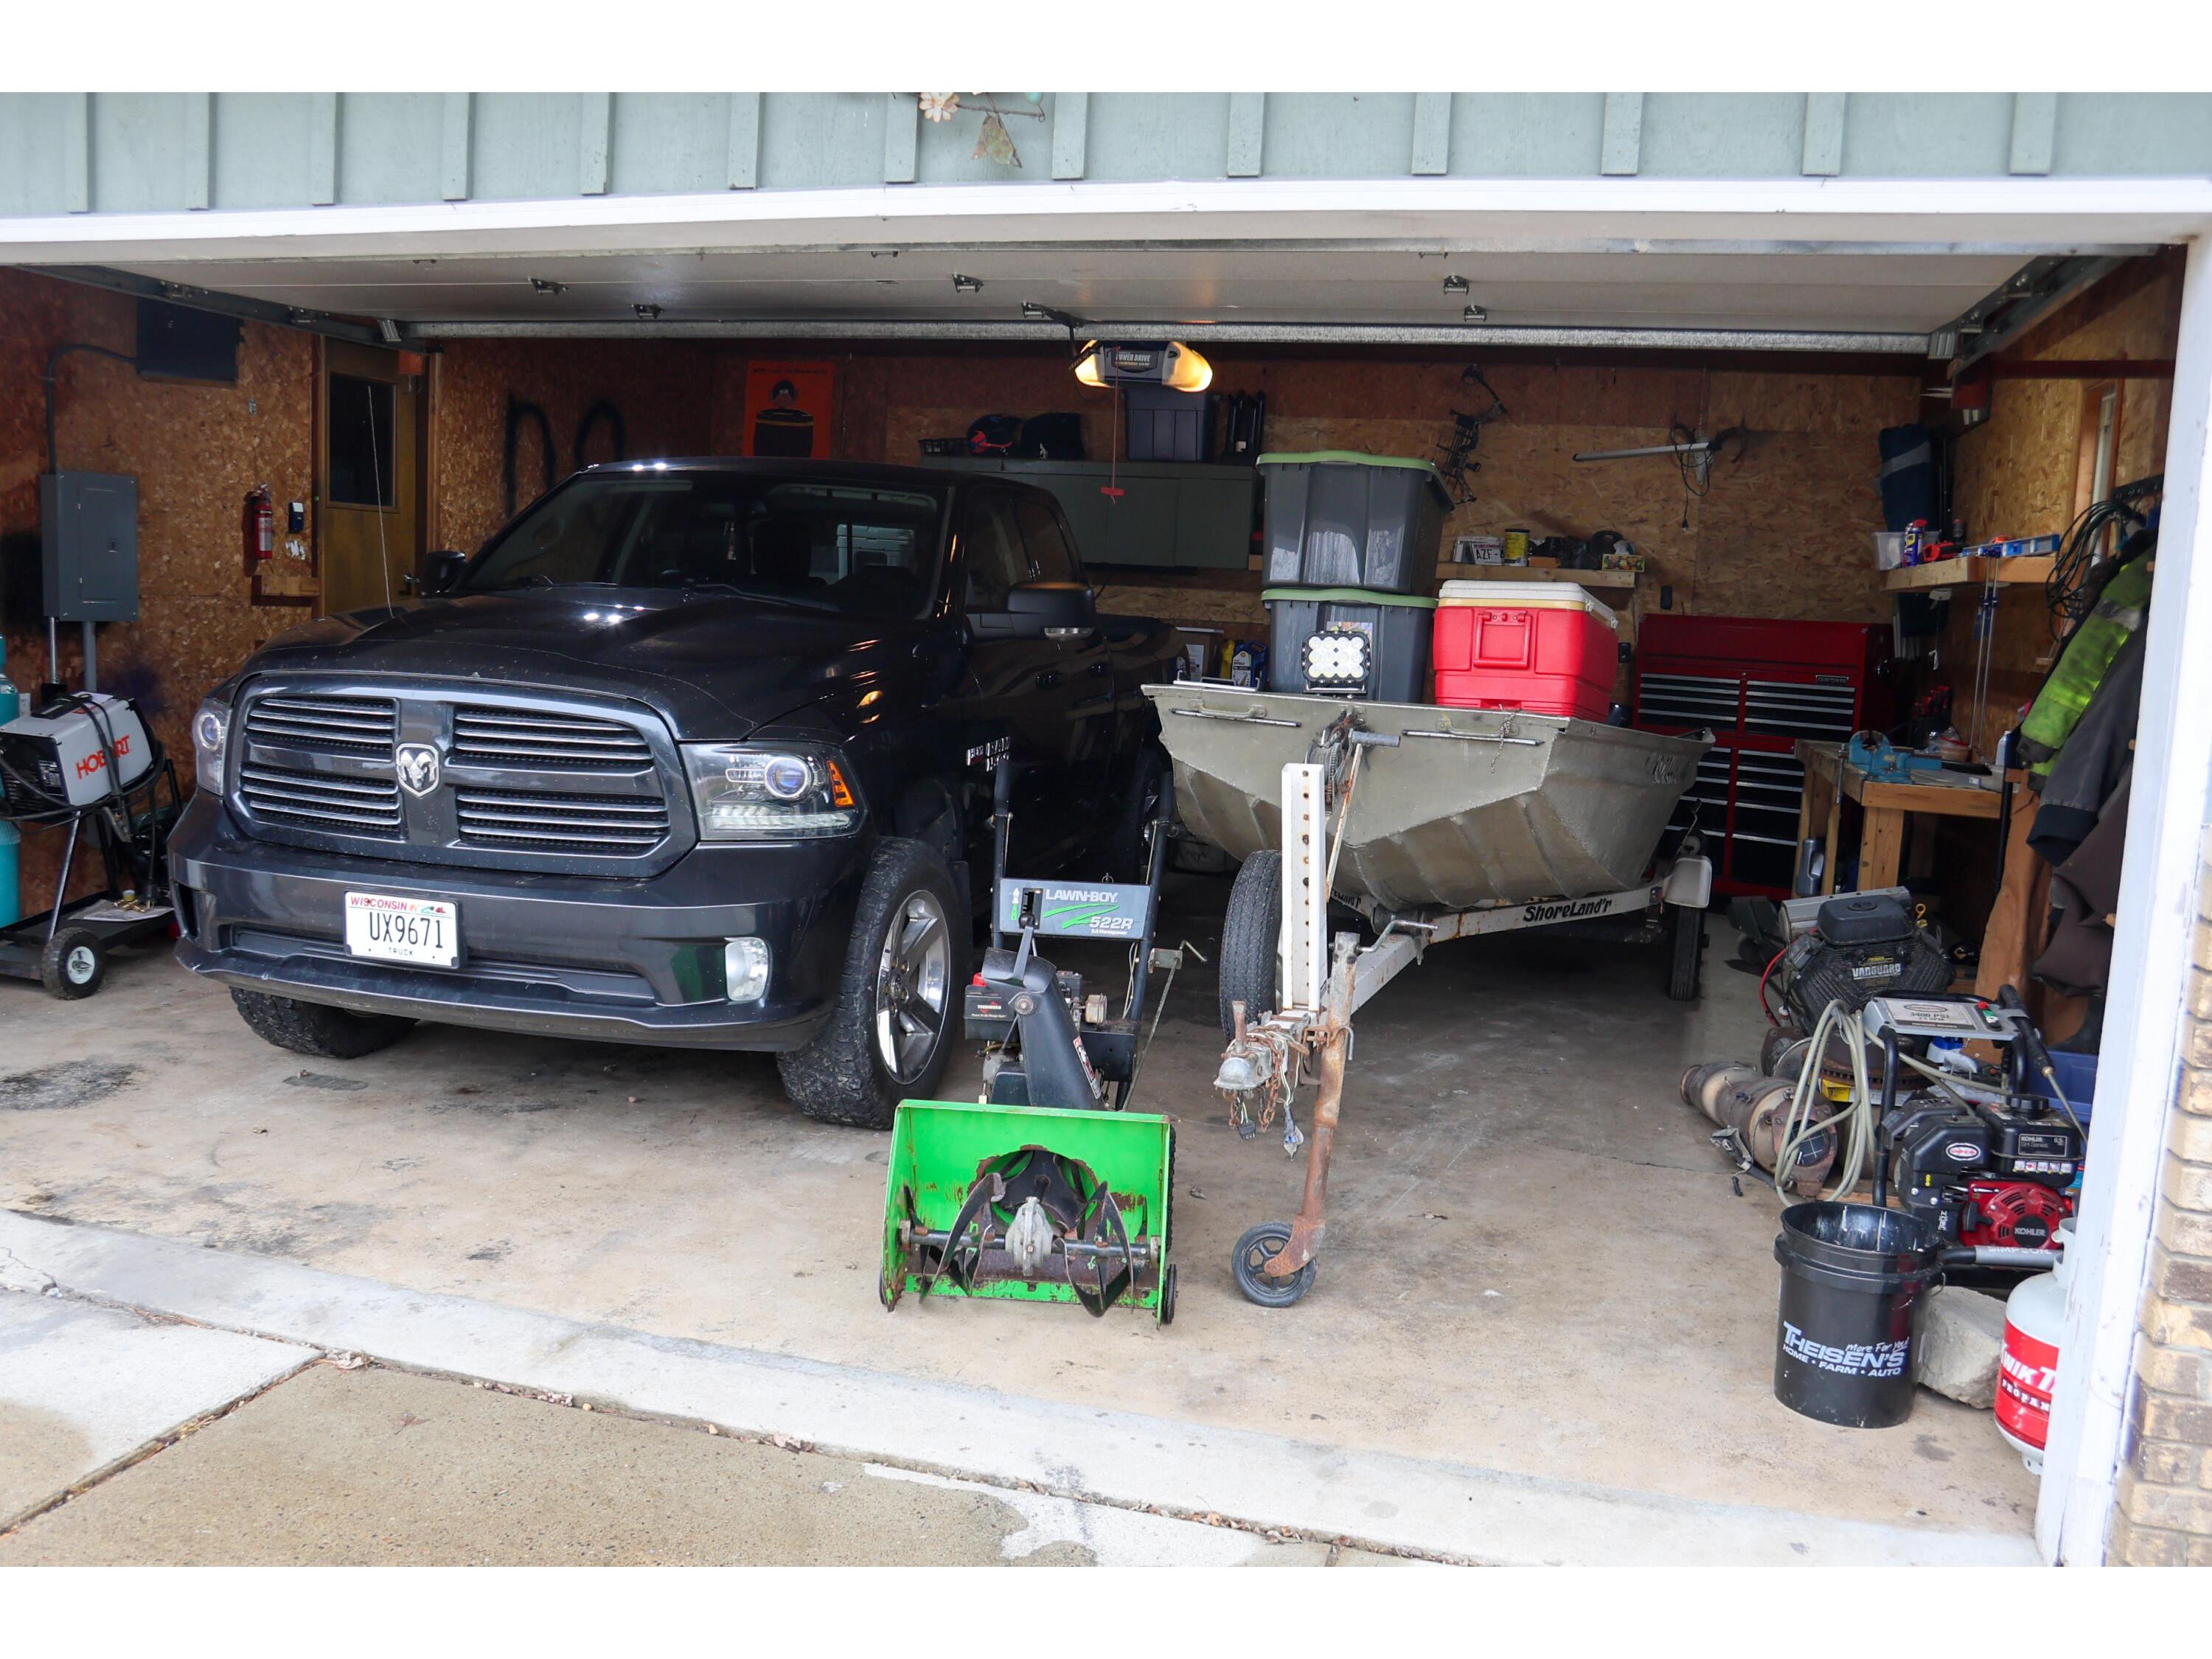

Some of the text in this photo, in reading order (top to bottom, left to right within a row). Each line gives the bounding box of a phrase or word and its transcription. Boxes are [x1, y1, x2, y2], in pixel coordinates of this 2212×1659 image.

[351, 896, 407, 910] WISCONSIN
[1046, 889, 1119, 902] LAWN-BOY
[1523, 897, 1613, 922] ShoreLand'r
[369, 911, 443, 948] UX9671
[1089, 916, 1134, 930] 522R
[389, 947, 414, 956] TRUCK
[1851, 963, 1901, 978] VANGUARD
[2014, 1227, 2046, 1237] KOHLER
[1783, 1321, 1905, 1368] THEISEN'S
[1783, 1344, 1902, 1377] HOME FARM AUTO
[2002, 1378, 2051, 1412] PROPAN
